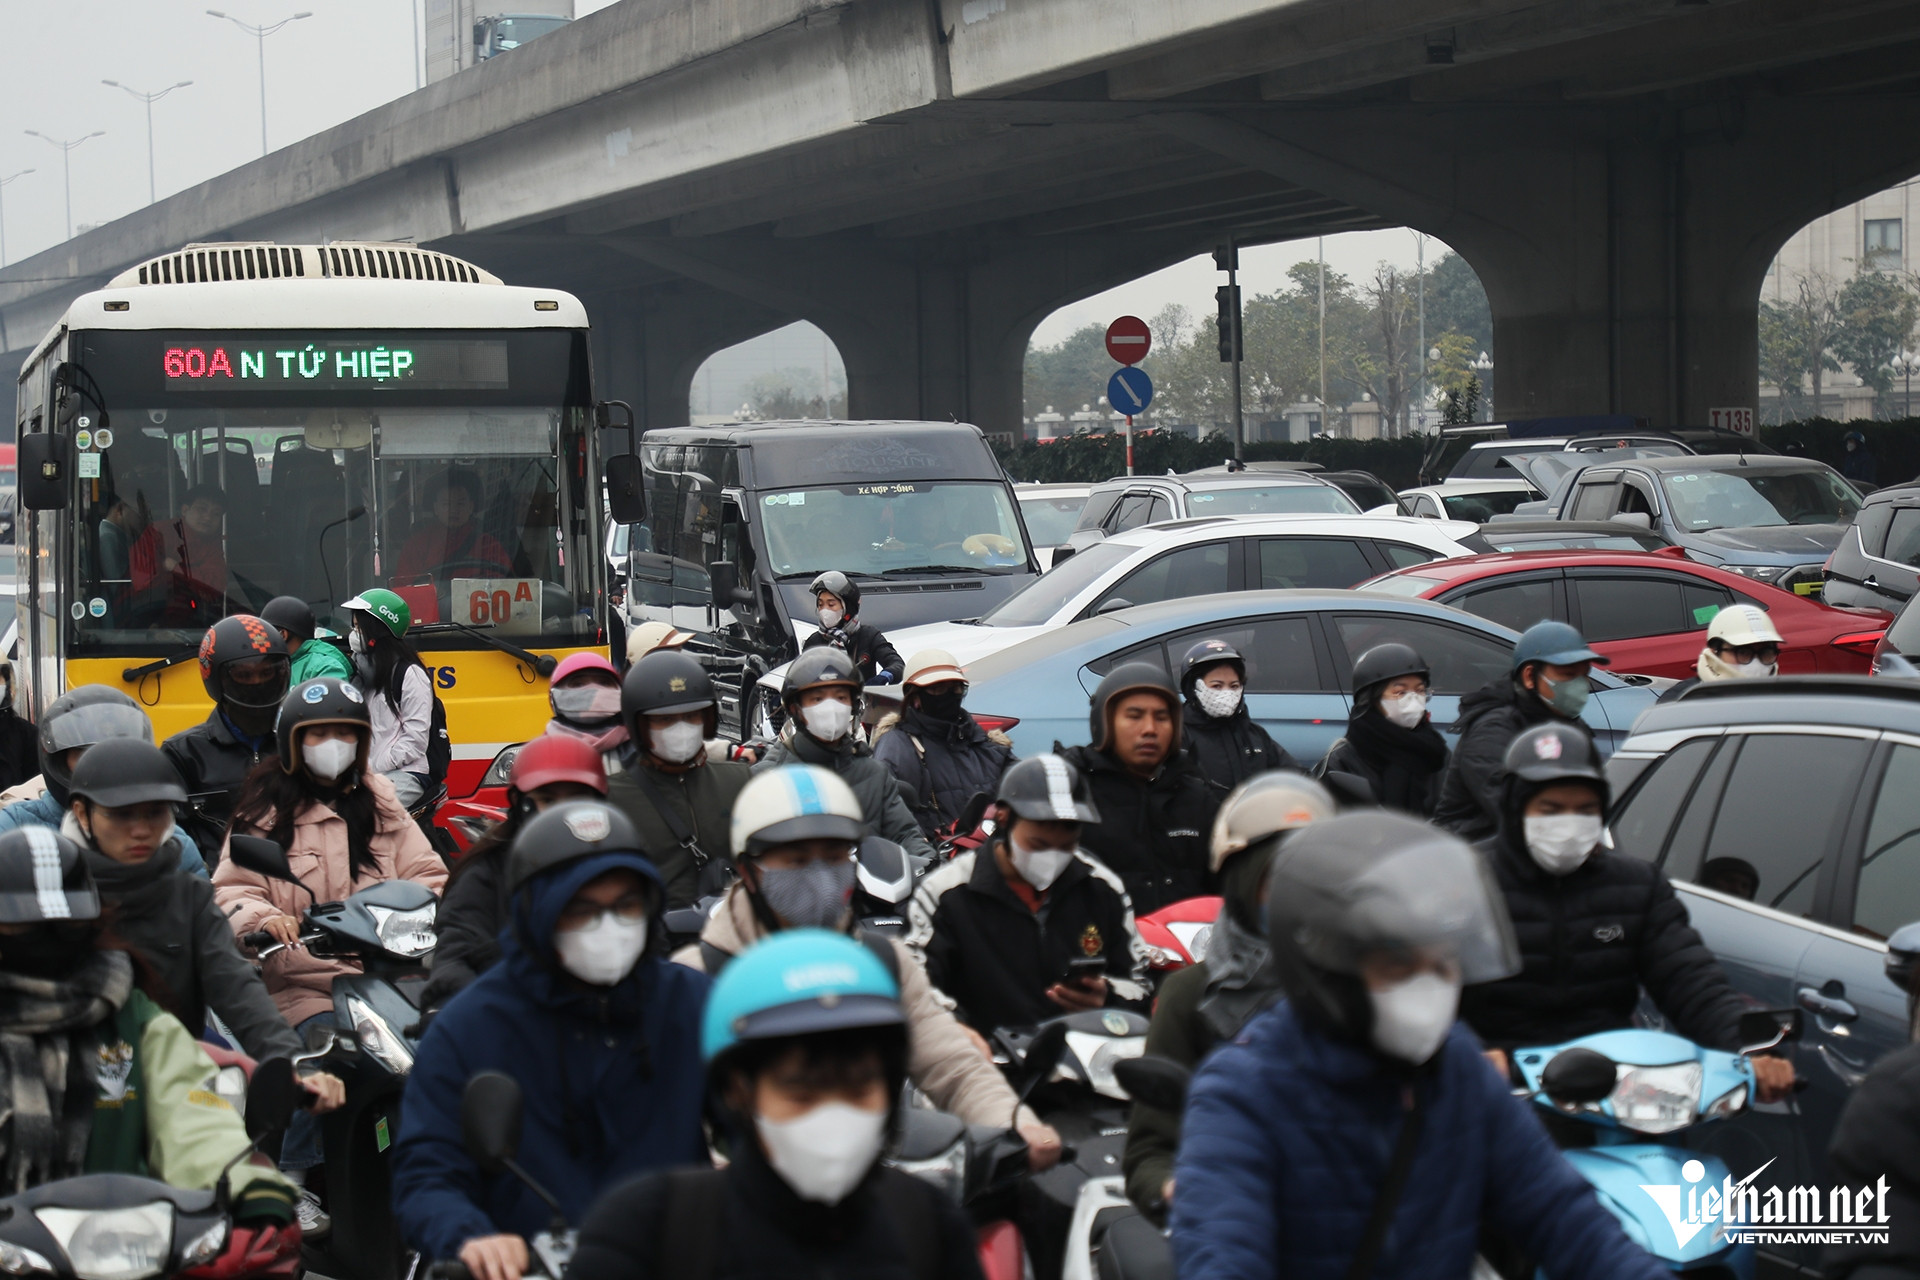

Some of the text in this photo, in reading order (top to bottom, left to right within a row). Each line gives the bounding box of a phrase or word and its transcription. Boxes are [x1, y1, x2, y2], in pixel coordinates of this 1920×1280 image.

[164, 347, 234, 378] 60A
[240, 351, 264, 379] N
[275, 344, 326, 379] TỨ
[1725, 410, 1752, 433] 135
[378, 604, 400, 625] Grab
